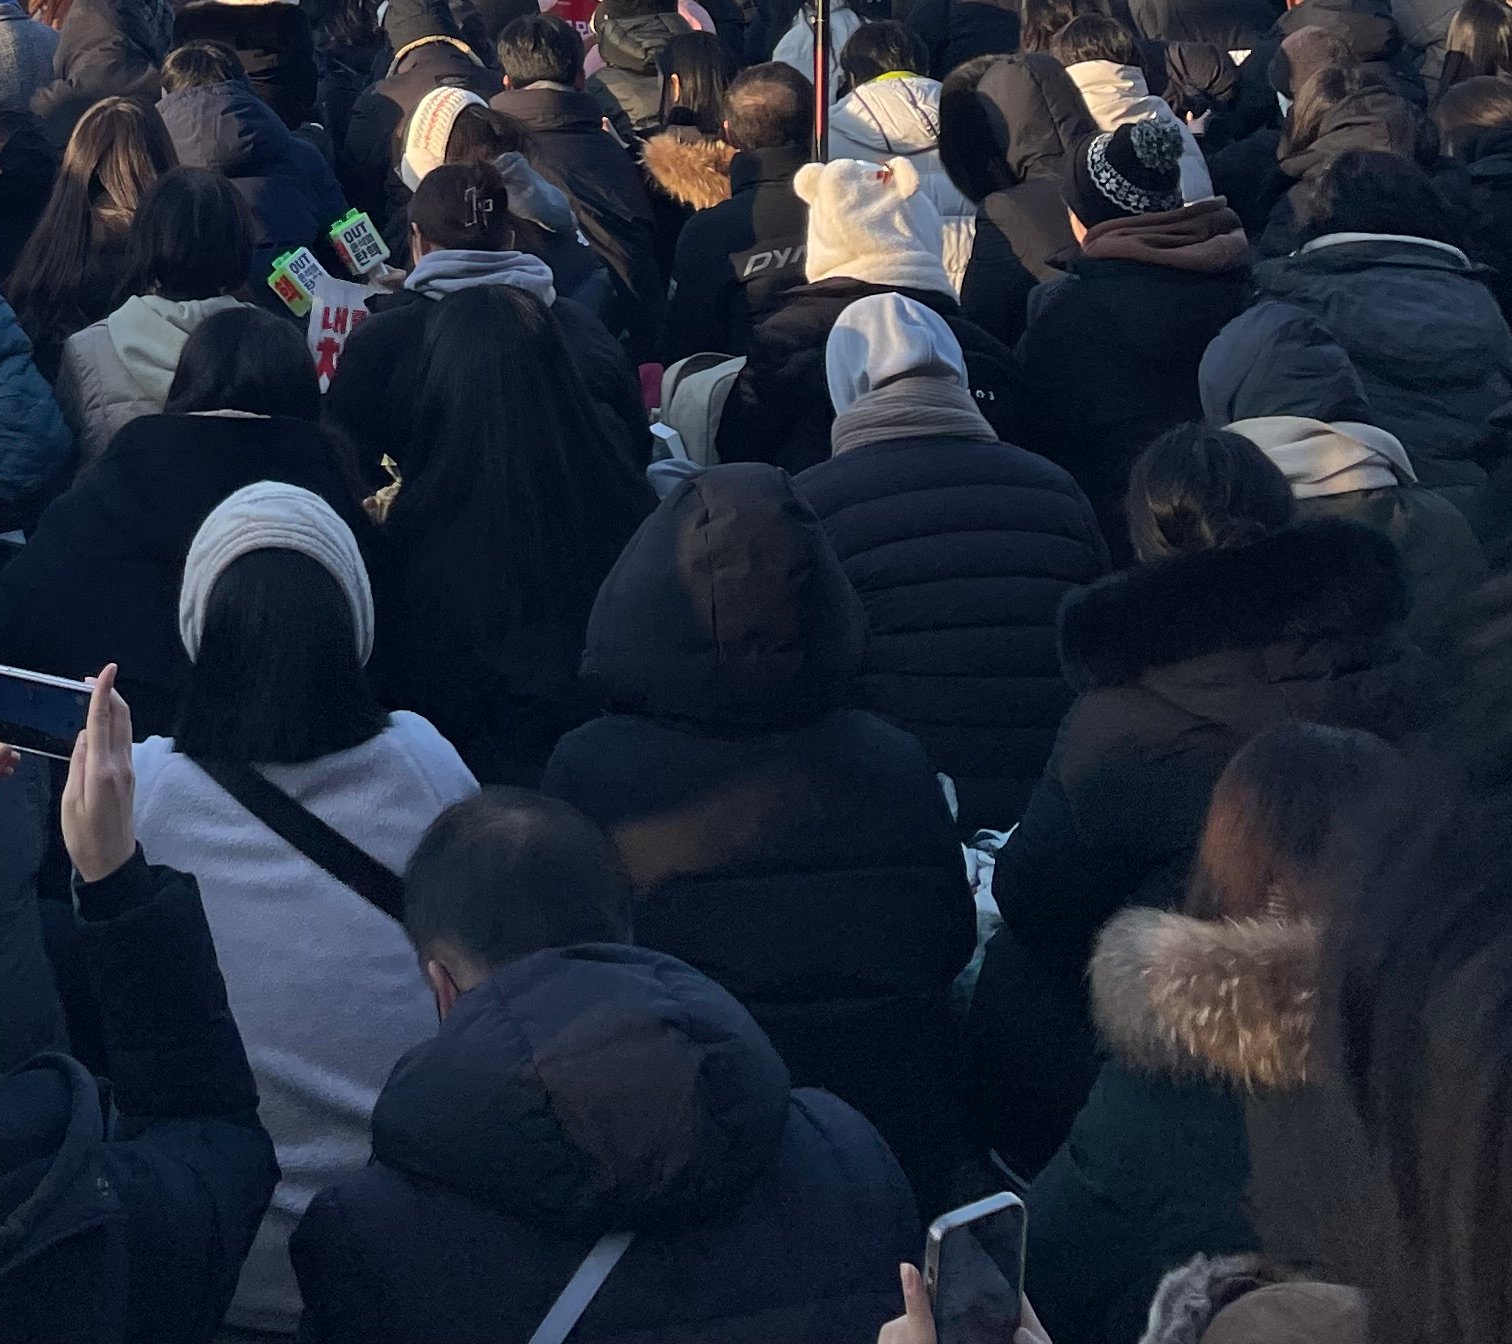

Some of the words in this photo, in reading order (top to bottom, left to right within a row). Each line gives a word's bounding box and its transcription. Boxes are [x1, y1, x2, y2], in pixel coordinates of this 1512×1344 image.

[343, 221, 368, 244] OUT
[289, 252, 312, 275] OUT
[354, 242, 382, 267] 탄핵
